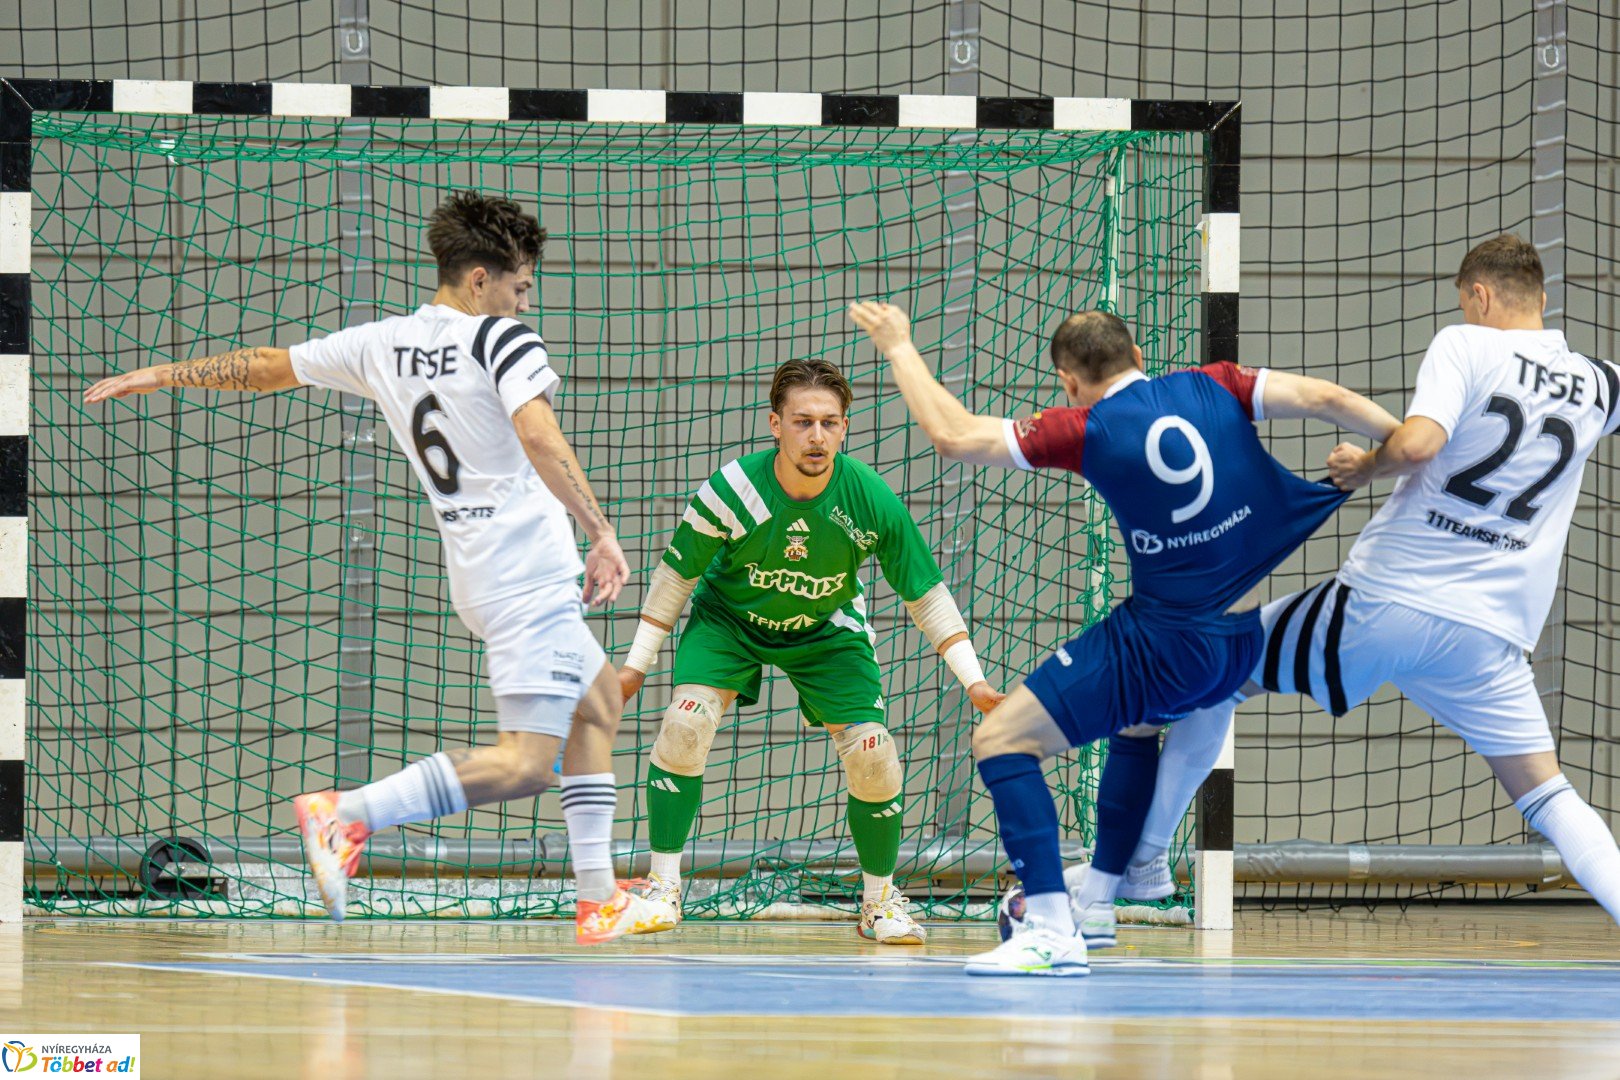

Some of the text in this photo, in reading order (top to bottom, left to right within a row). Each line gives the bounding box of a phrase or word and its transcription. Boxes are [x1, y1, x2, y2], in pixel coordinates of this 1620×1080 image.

[394, 344, 457, 379] TFSE
[1514, 352, 1585, 407] TFSE
[412, 393, 459, 495] 6
[1145, 415, 1214, 524] 9
[1442, 393, 1576, 525] 22
